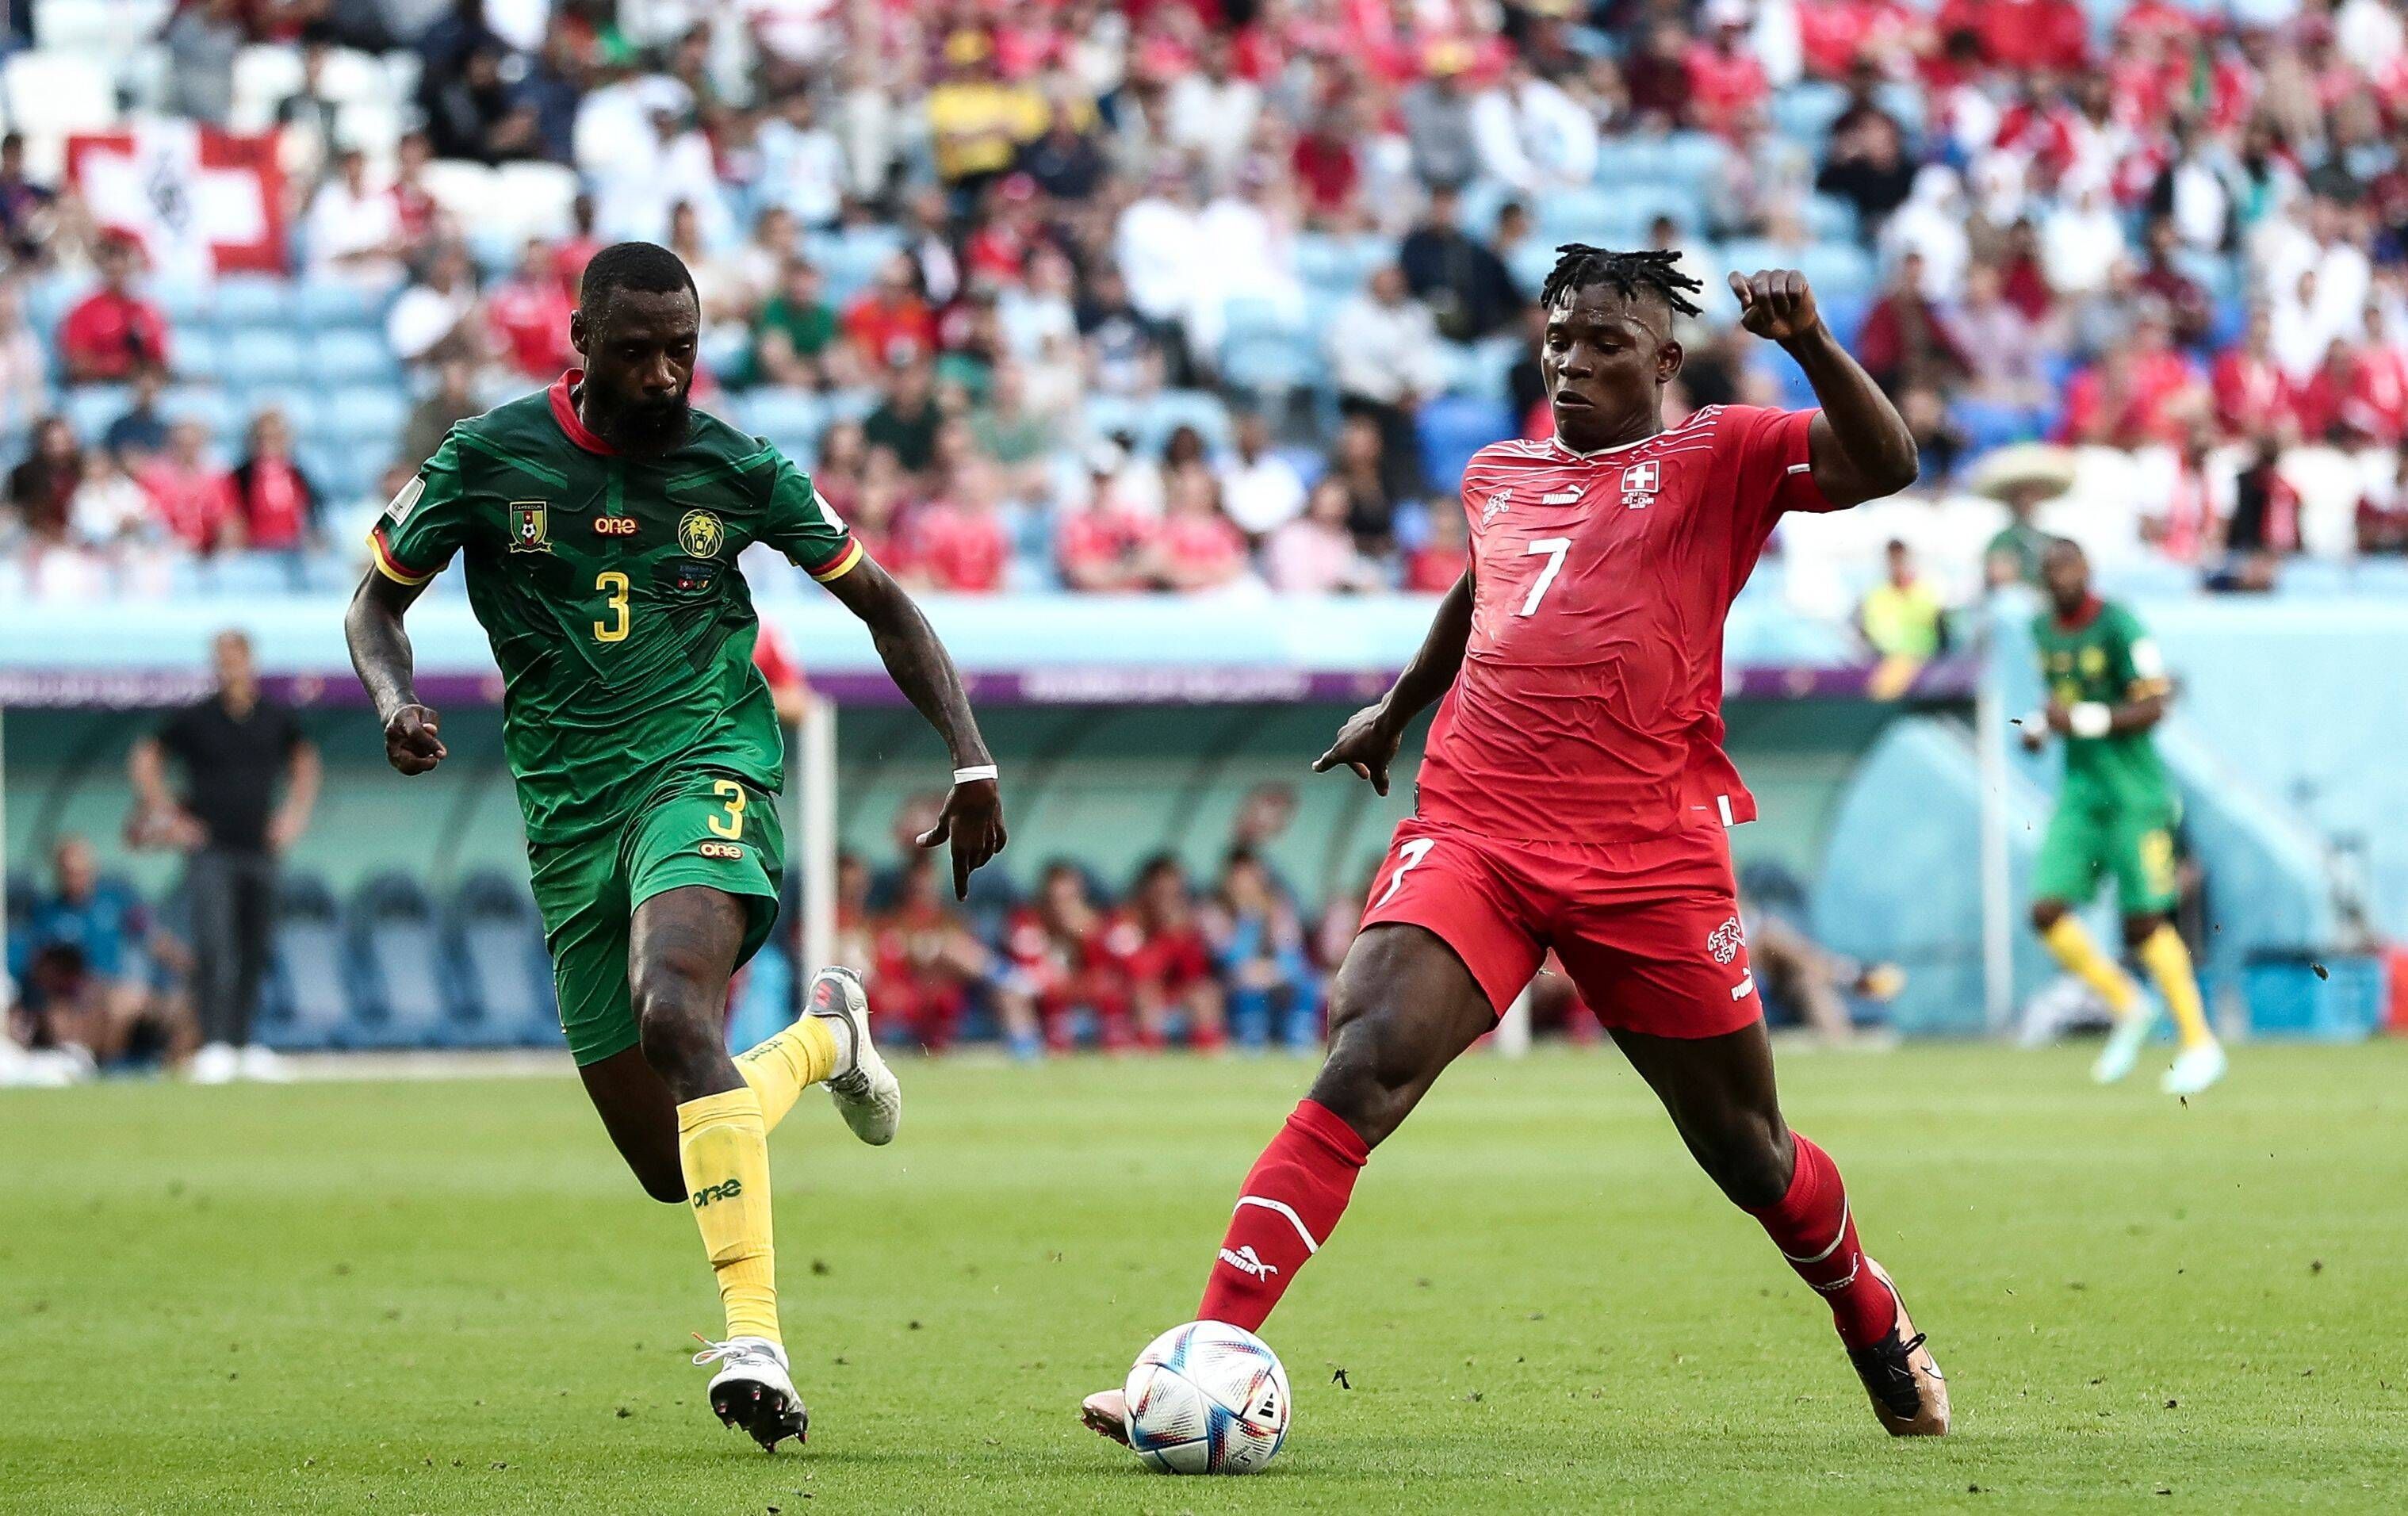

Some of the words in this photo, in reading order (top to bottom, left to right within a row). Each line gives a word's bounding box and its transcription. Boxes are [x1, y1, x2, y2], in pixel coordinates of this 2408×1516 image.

[595, 517, 636, 534] one
[1520, 537, 1572, 617] 7
[594, 571, 630, 642] 3
[708, 779, 746, 840] 3
[700, 843, 743, 859] one
[1374, 837, 1435, 909] 7
[692, 1178, 742, 1208] one
[1219, 1247, 1258, 1276] PUMA
